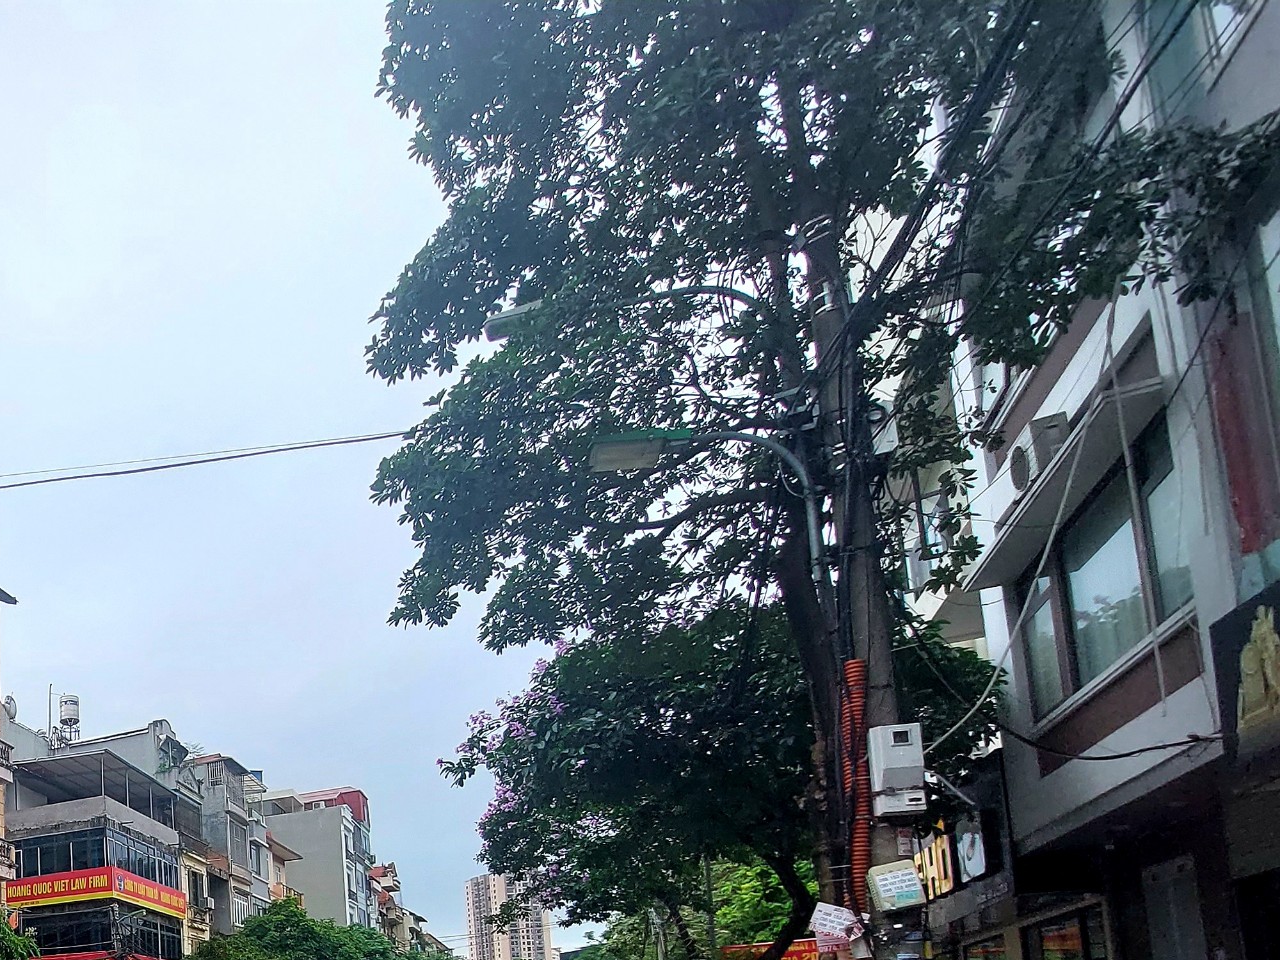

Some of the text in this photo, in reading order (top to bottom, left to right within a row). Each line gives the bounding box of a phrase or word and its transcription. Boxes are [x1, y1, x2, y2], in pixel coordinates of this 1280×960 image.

[7, 875, 108, 898] HOANG QUOC VIET LAW FIRM
